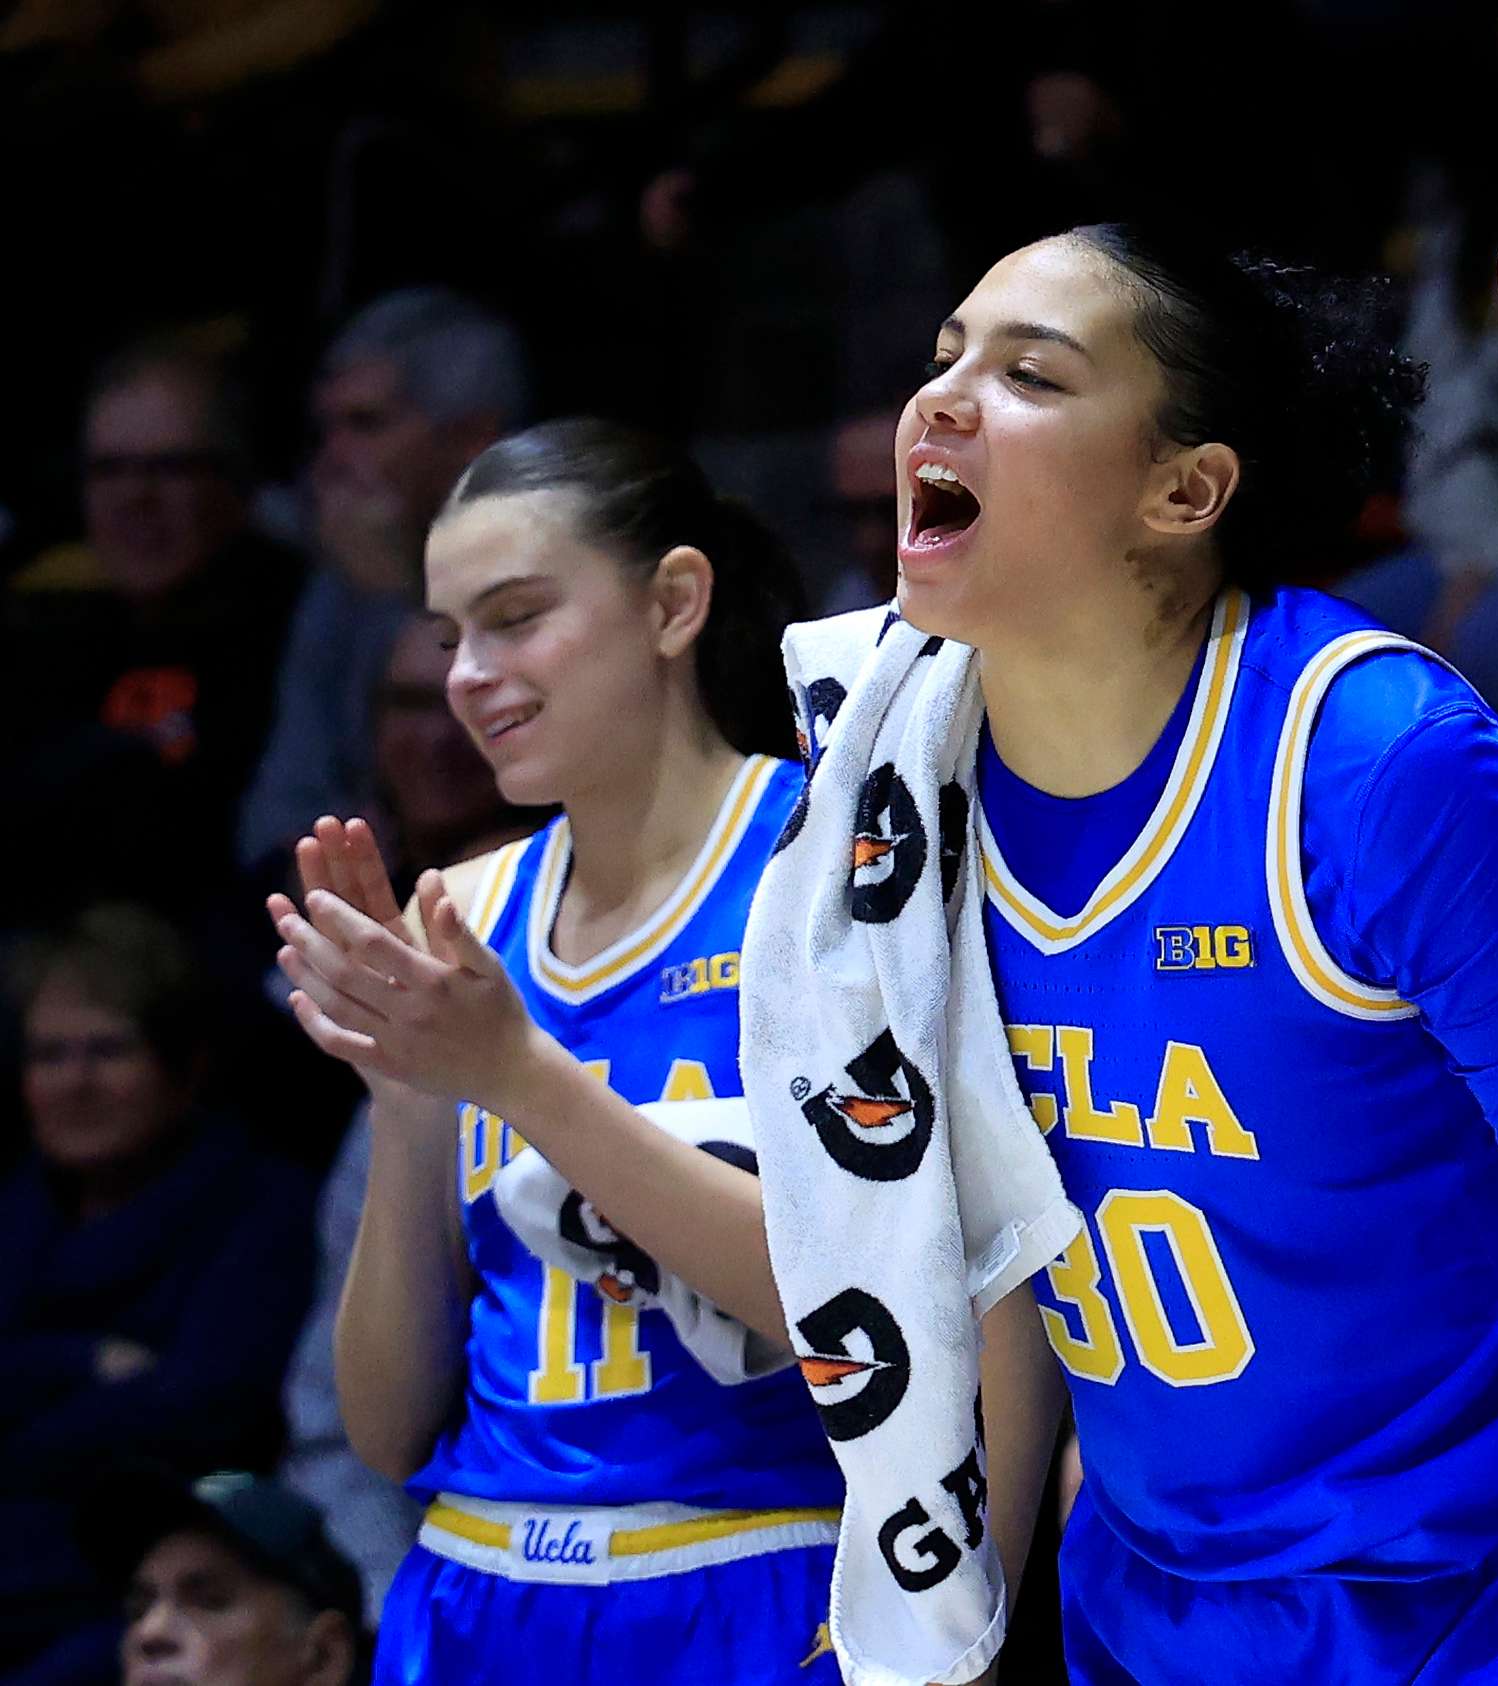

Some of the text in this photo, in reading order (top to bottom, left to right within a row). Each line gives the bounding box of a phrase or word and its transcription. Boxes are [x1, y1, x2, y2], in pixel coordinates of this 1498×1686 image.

[1004, 1024, 1260, 1160] CLA
[1037, 1188, 1256, 1388] 30
[522, 1518, 596, 1566] Ucla
[877, 1380, 988, 1592] GA
